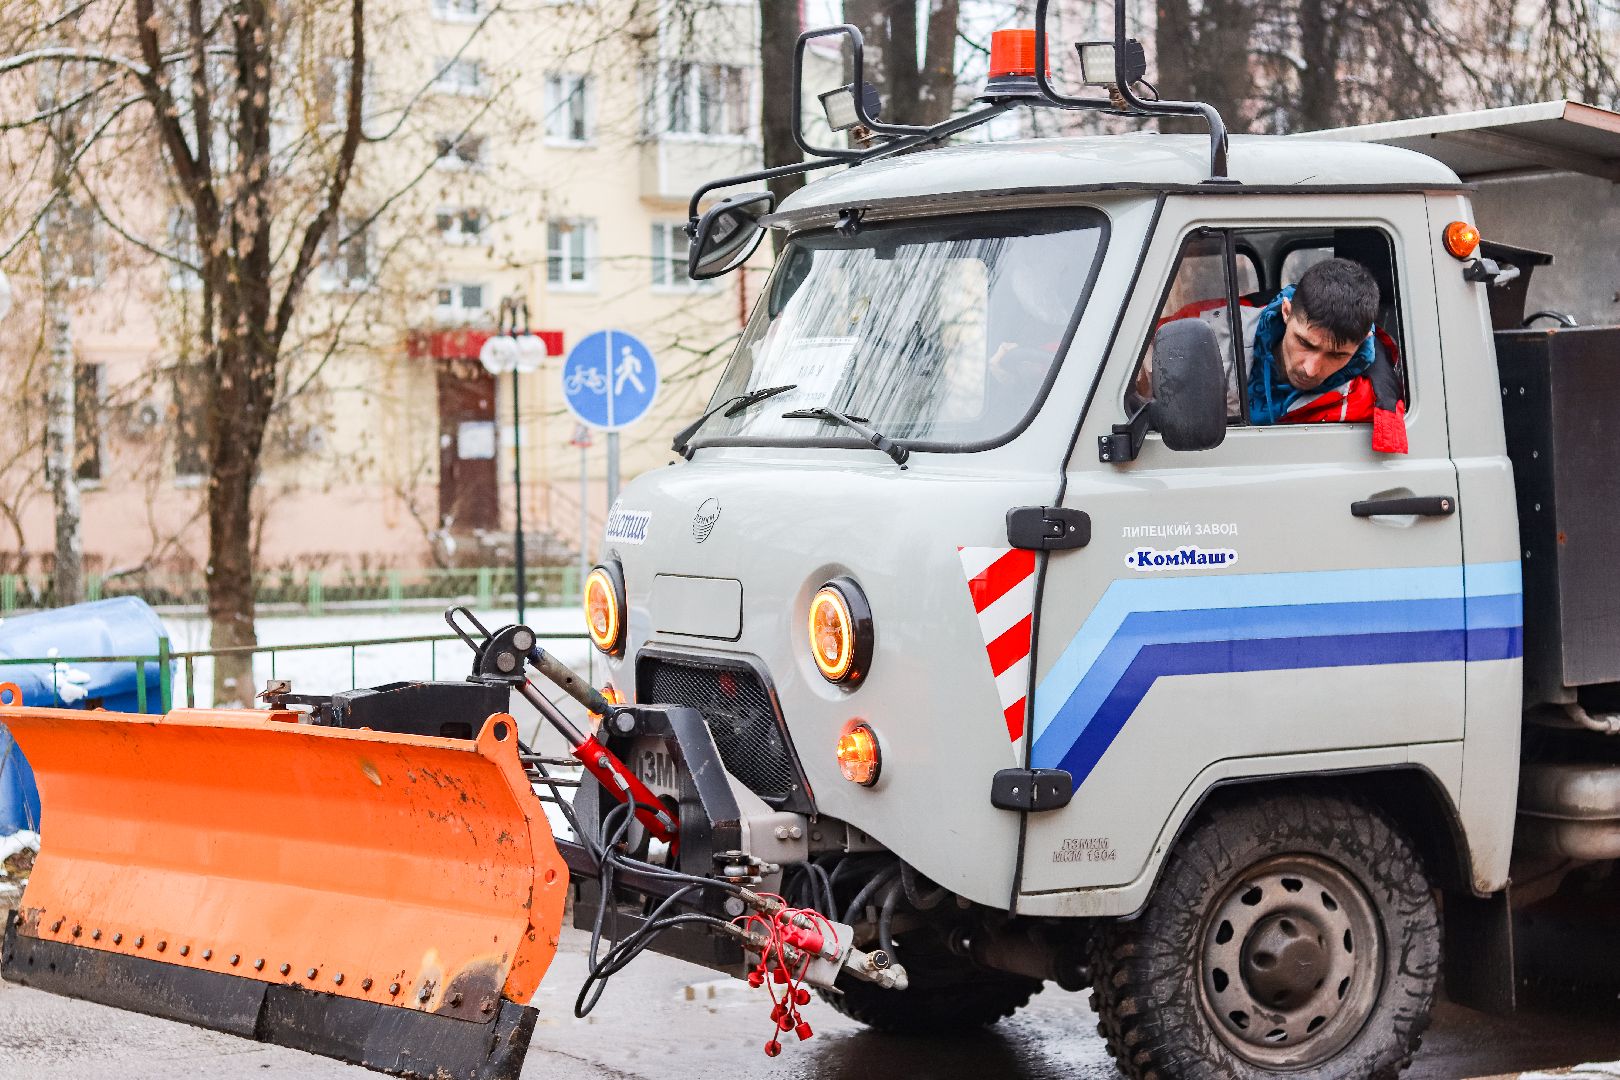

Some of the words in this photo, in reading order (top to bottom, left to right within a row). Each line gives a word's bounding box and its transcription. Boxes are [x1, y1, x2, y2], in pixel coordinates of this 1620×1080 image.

[1121, 522, 1192, 538] ЛИПЕЦКИЙ
[1195, 523, 1239, 536] ЗАВОД
[1086, 848, 1117, 862] 1904
